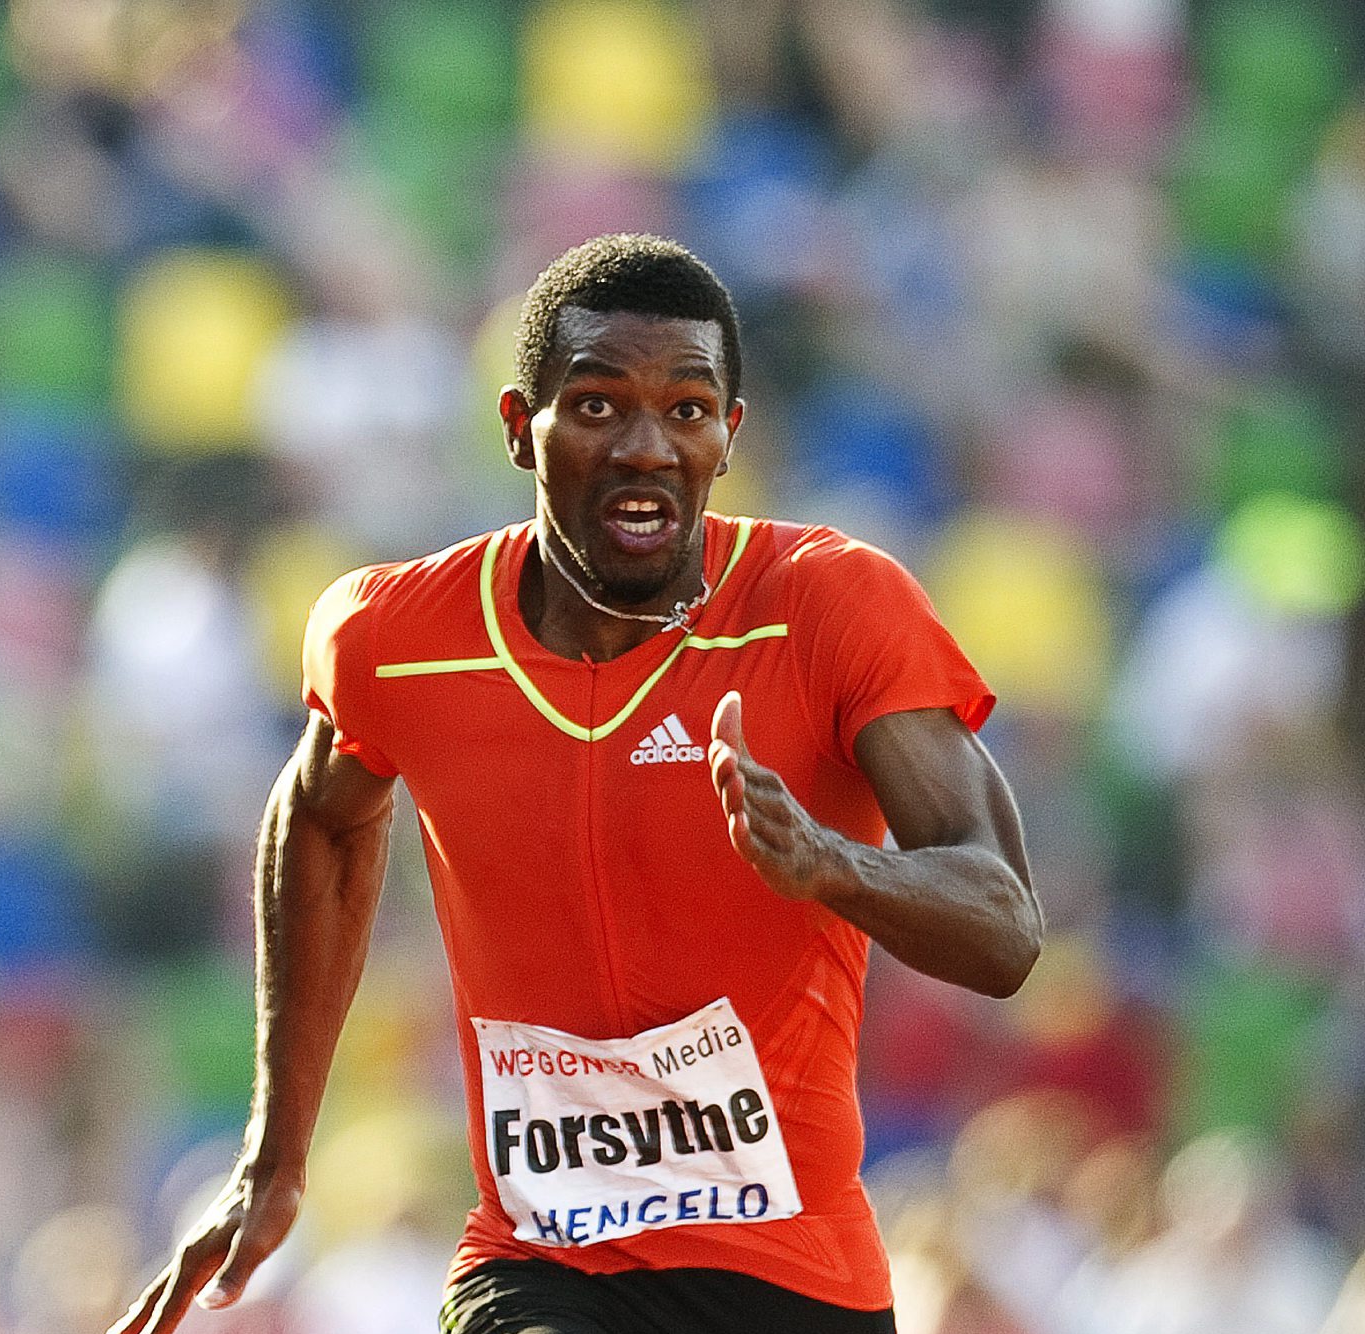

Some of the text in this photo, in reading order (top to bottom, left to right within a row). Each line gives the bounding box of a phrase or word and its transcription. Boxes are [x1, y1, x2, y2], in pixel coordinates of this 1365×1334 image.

[630, 744, 705, 766] adidas
[652, 1023, 743, 1078] Media
[491, 1088, 769, 1176] Forsythe
